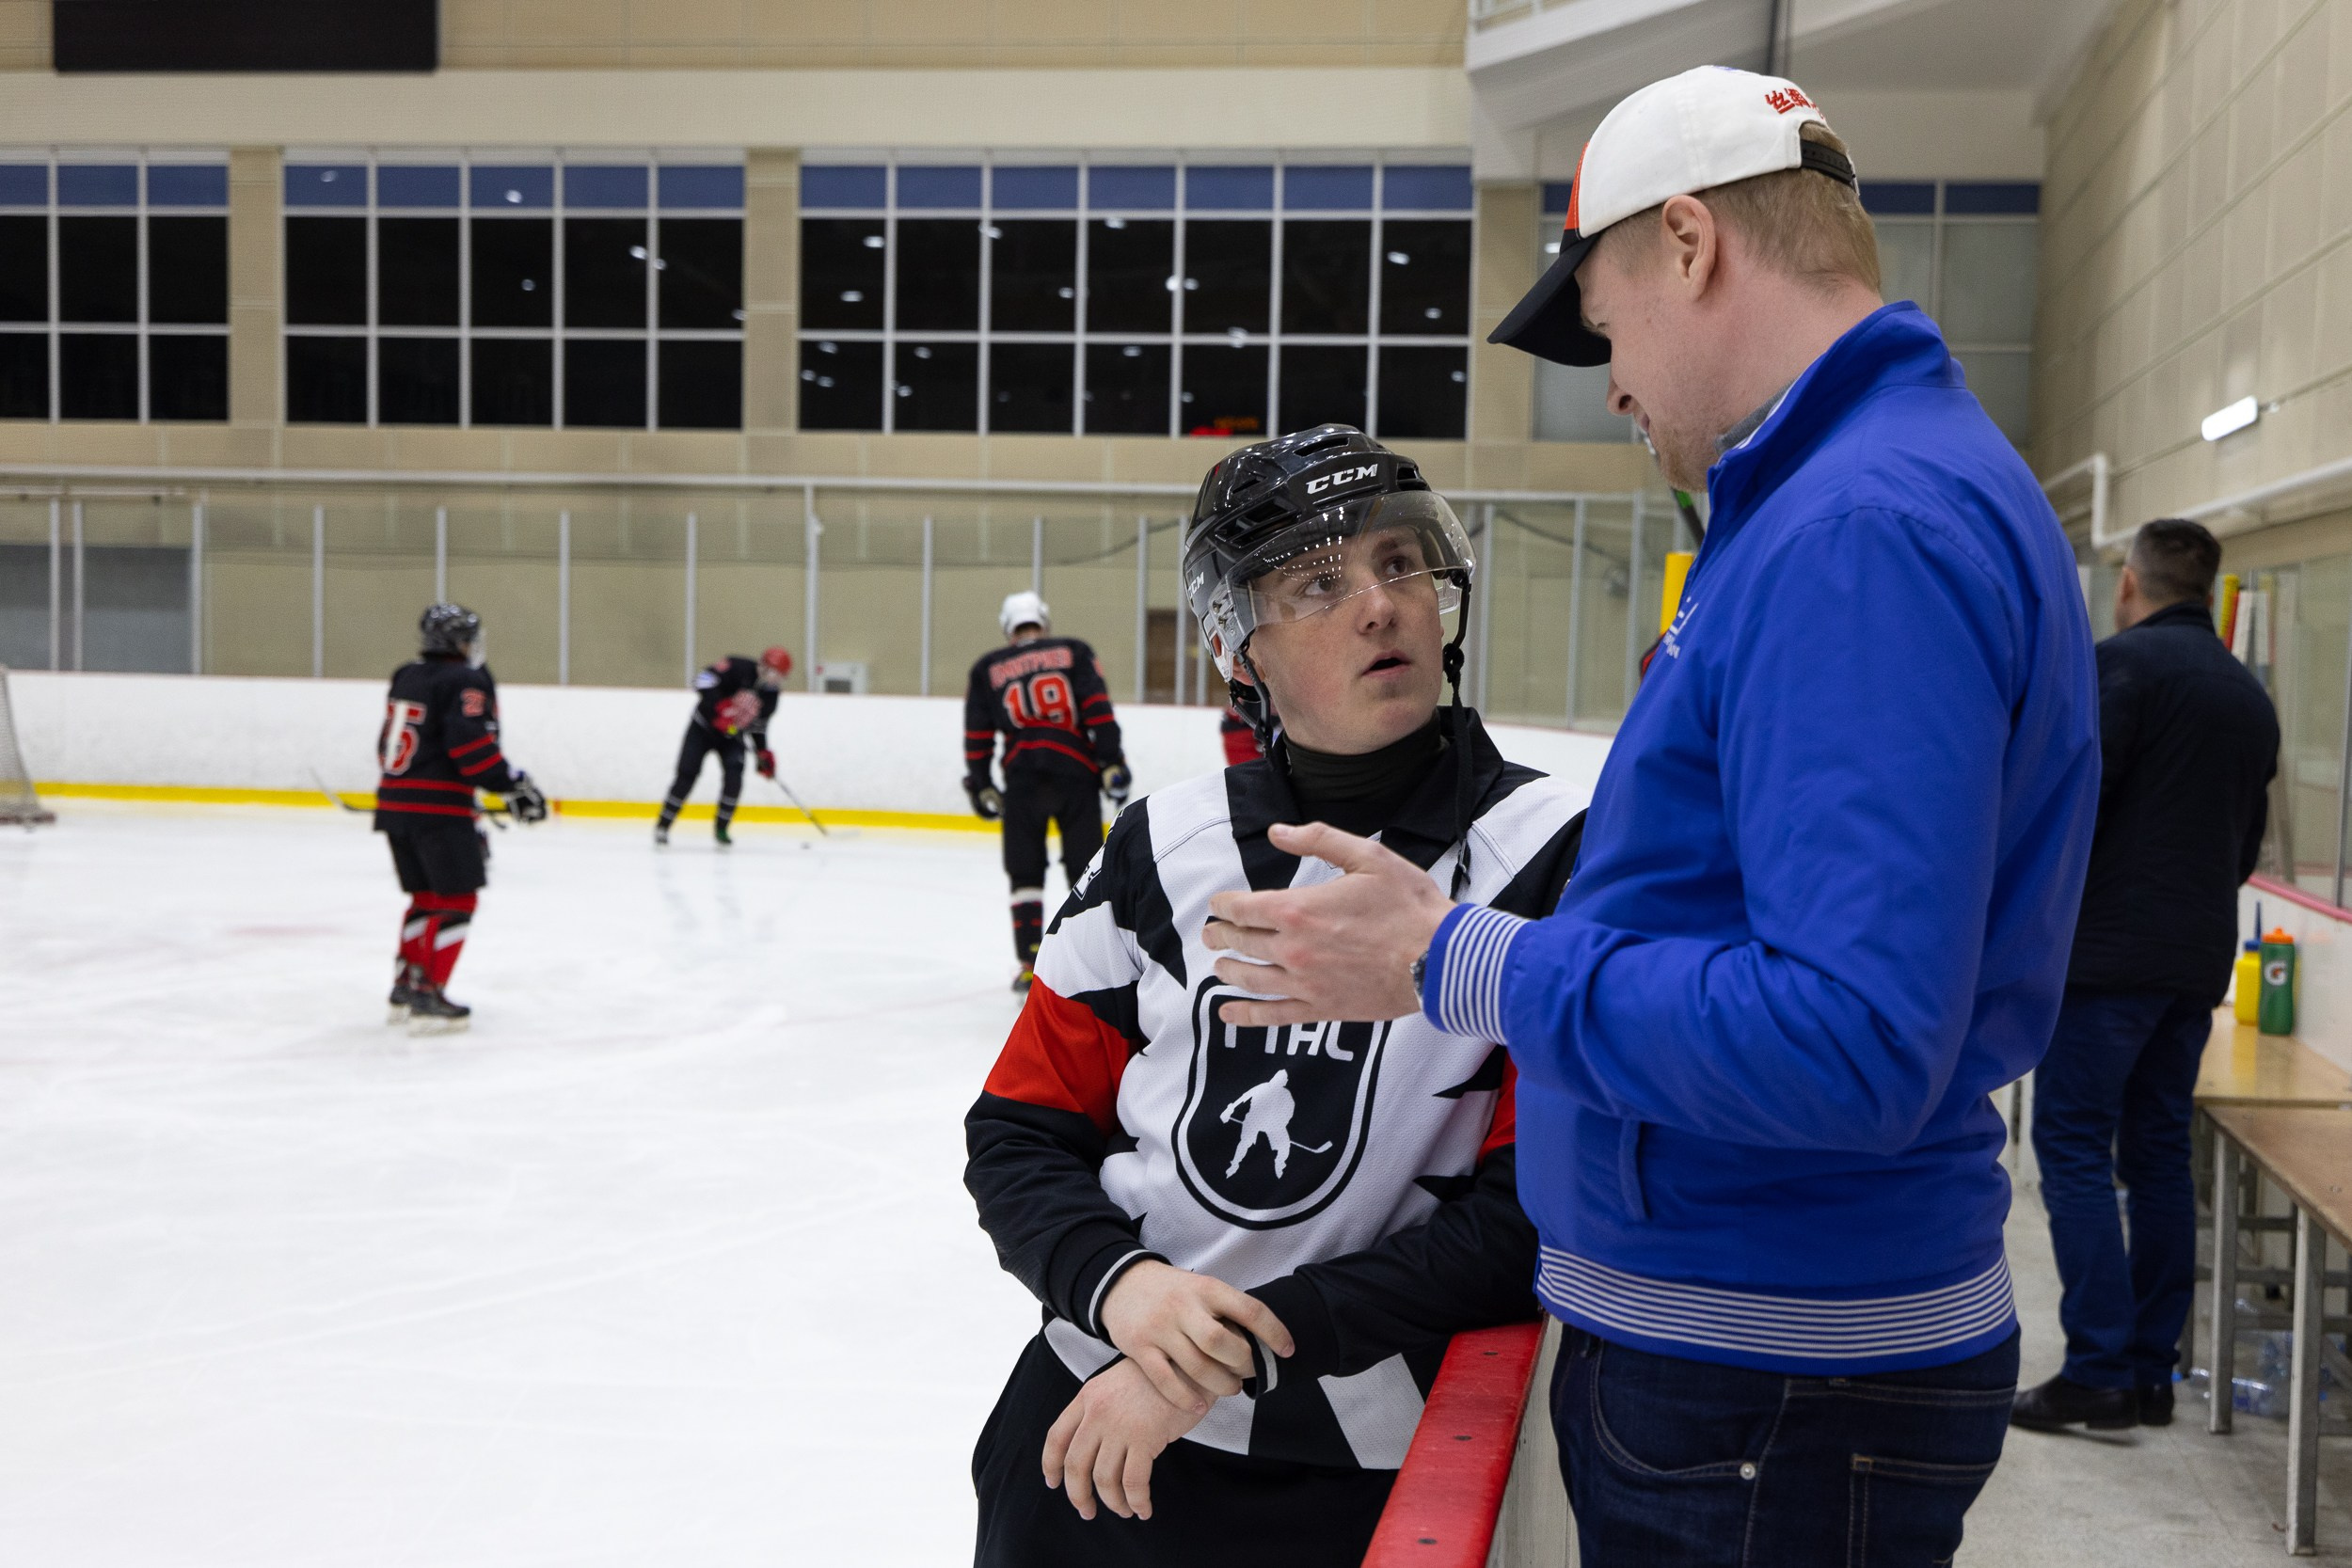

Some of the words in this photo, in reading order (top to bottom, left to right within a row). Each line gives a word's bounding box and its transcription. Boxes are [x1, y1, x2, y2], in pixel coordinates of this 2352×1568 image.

[1306, 464, 1378, 495] CCM
[1003, 671, 1078, 730] 19
[2264, 960, 2287, 986] G
